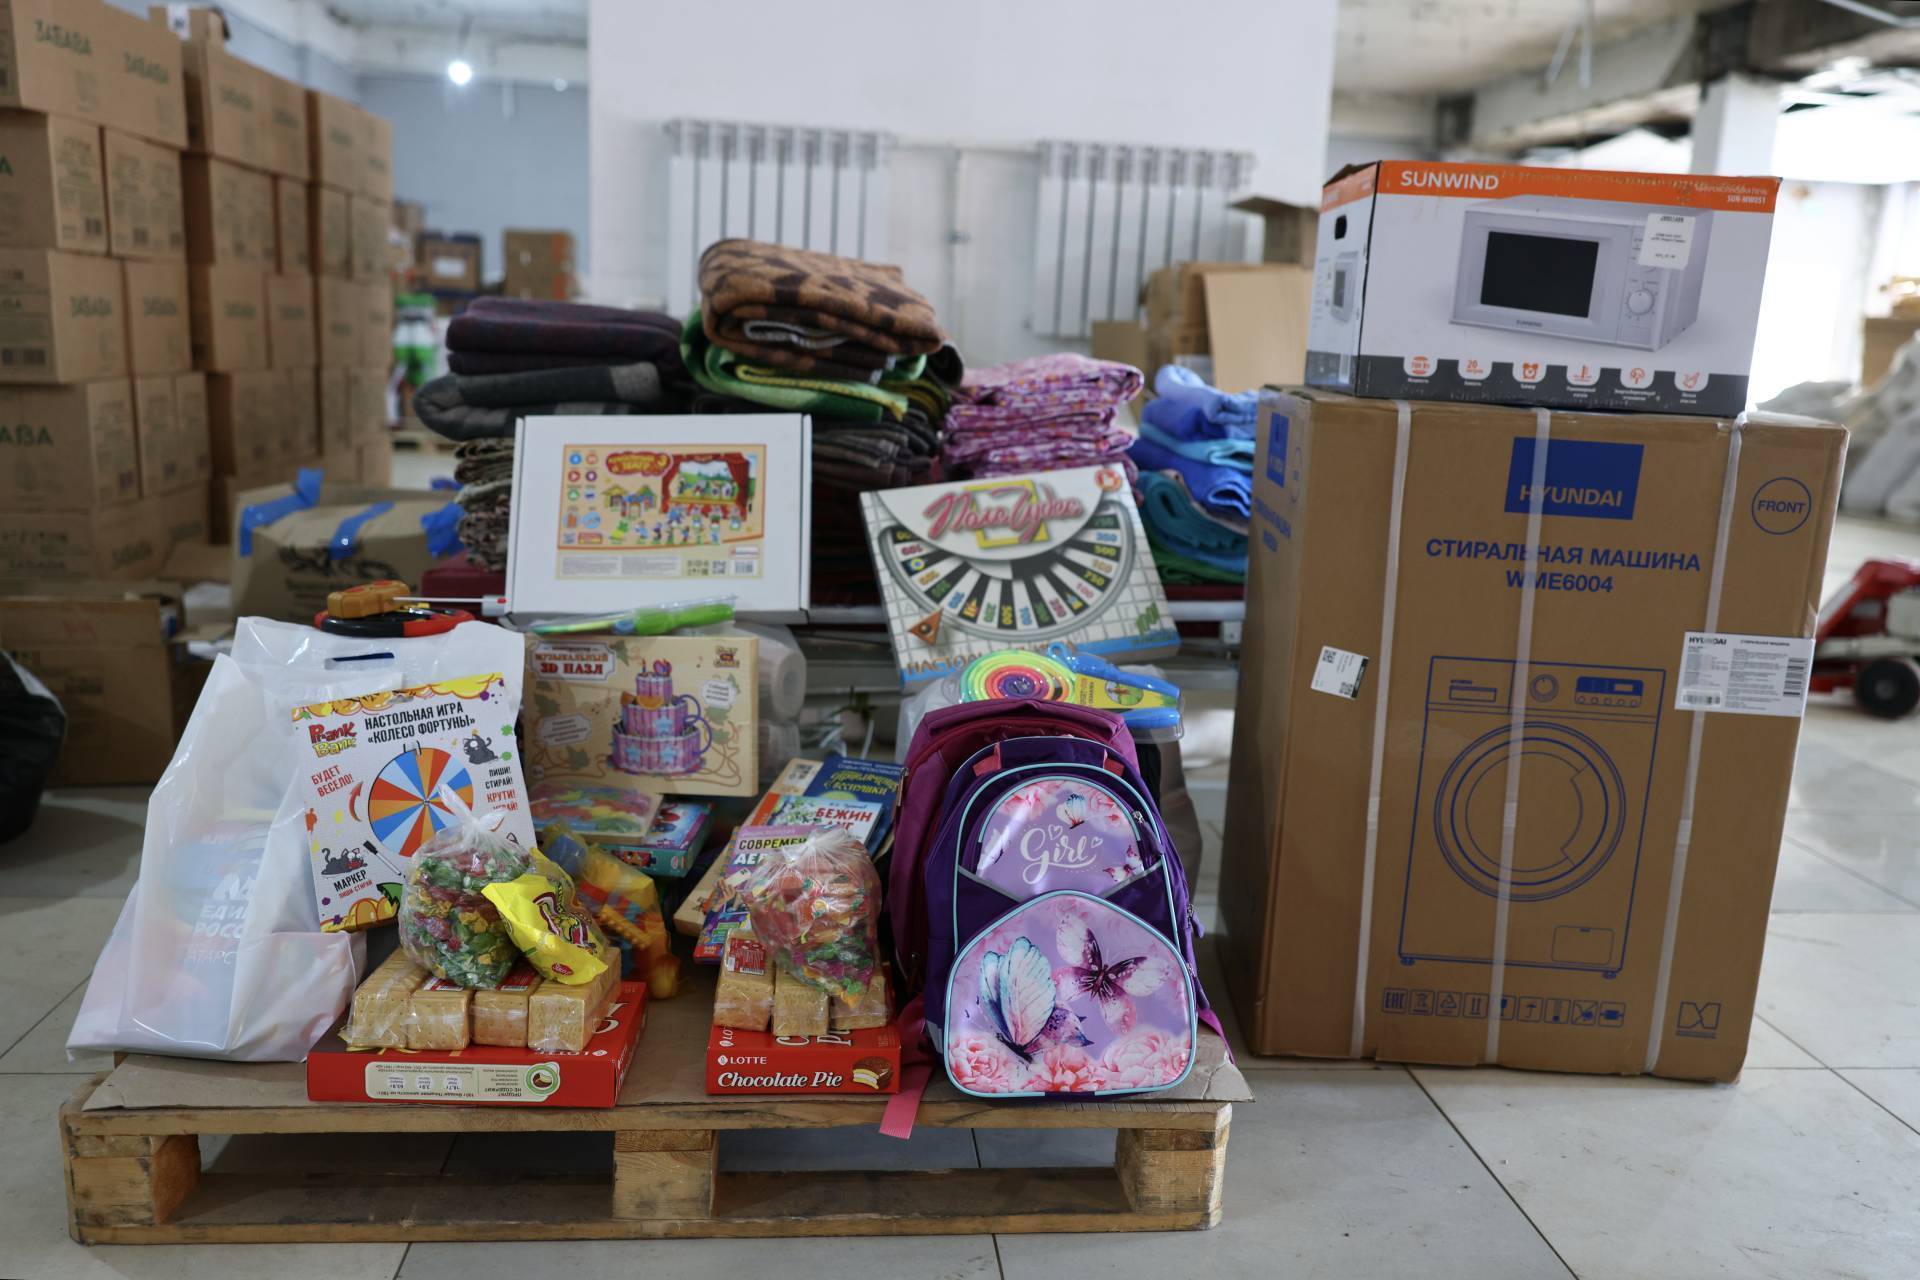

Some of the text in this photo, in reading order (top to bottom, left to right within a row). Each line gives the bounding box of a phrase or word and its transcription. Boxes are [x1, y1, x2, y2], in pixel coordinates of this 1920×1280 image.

[1400, 170, 1499, 190] SUNWIND
[1519, 483, 1622, 508] HYUNDAI
[923, 483, 1085, 545] Поле Чудес
[1757, 500, 1806, 515] FRONT
[1426, 538, 1701, 572] СТИРАЛЬНАЯ МАШИНА
[1506, 570, 1614, 594] WME6004
[563, 662, 604, 675] ПАЗЛ
[364, 701, 464, 730] НАСТОЛЬНАЯ ИГРА
[367, 714, 476, 744] «КОЛЕСО ФОРТУНЫ»
[311, 765, 342, 785] БУДЕТ
[489, 766, 512, 777] ПИШИ!
[317, 774, 354, 798] ВЕСЕЛО!
[485, 776, 514, 789] СТИРАЙ!
[487, 789, 516, 803] КРУТИ!
[815, 807, 872, 822] БЕЖИН
[1020, 828, 1097, 885] Girl
[333, 869, 367, 892] МАРКЕР
[730, 1056, 767, 1065] LOTTE
[717, 1071, 843, 1087] Chocolate Pie
